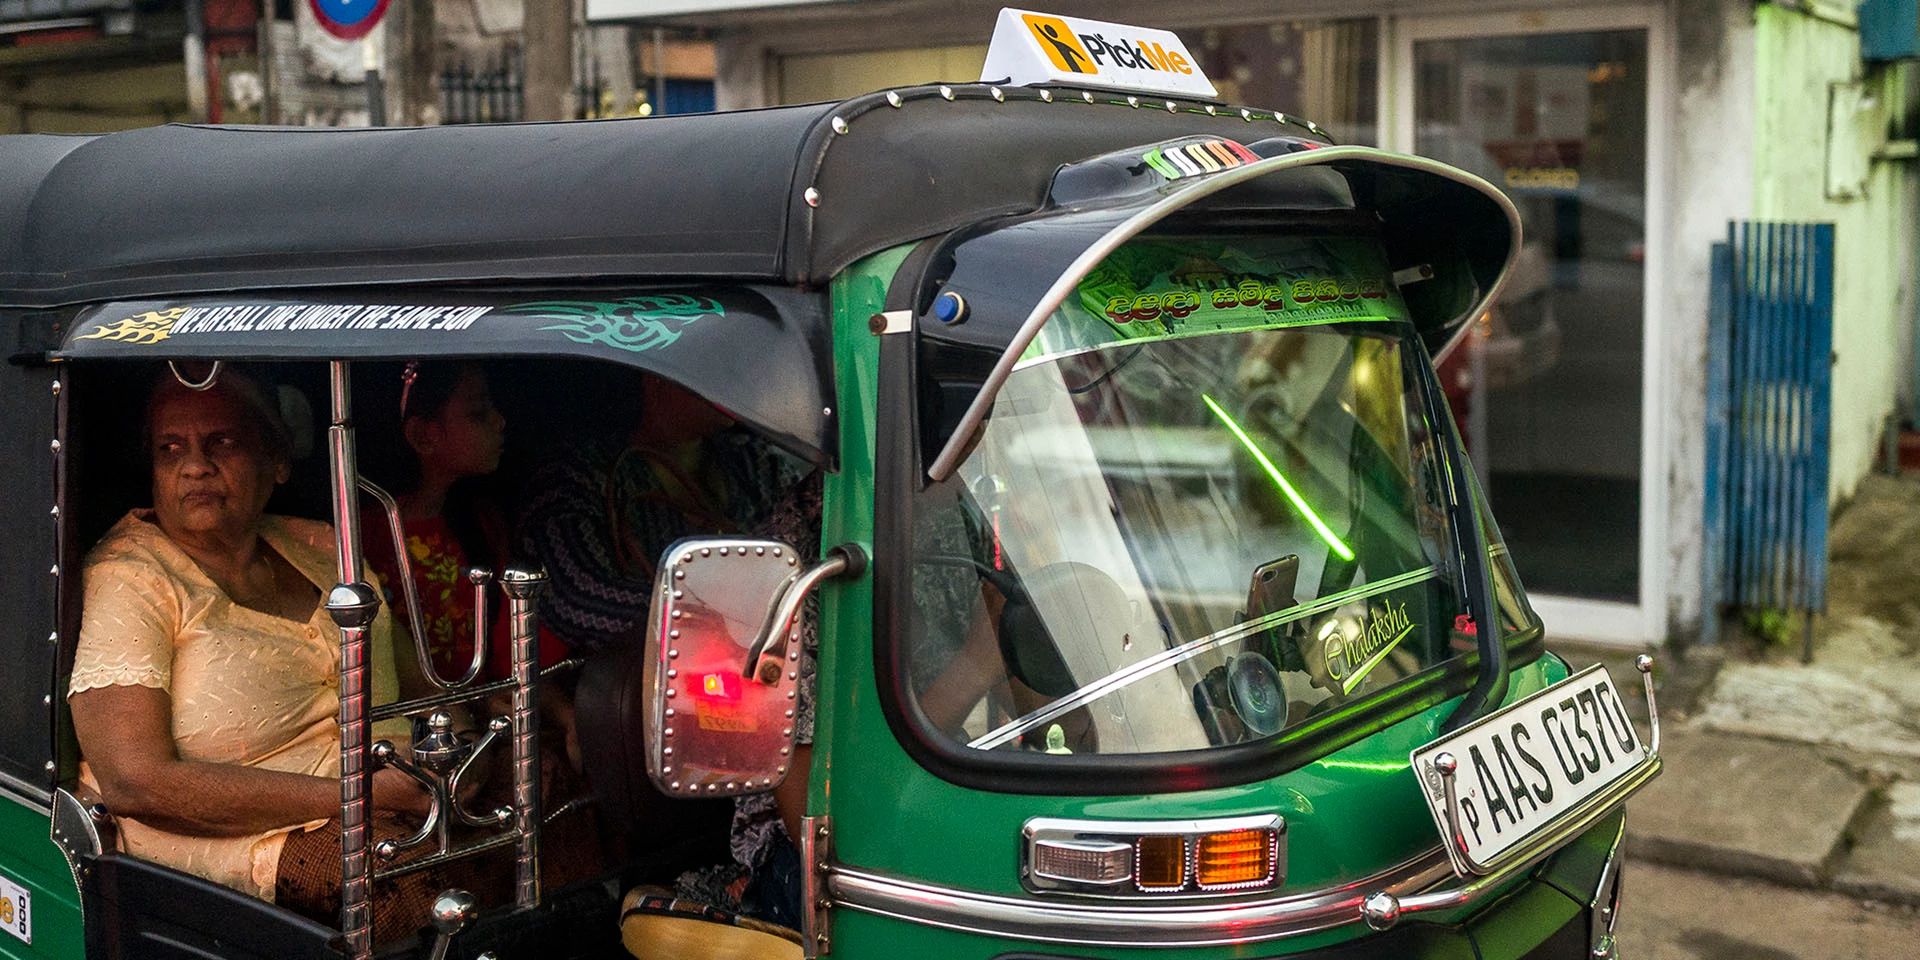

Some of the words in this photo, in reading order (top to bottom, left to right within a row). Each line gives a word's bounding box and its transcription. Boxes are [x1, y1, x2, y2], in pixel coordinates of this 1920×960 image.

[1078, 33, 1192, 75] PickMe
[168, 307, 210, 334] WE
[255, 305, 306, 331] ONE
[289, 304, 364, 331] UNDER
[346, 305, 402, 329] THE
[379, 306, 454, 330] SAME
[432, 306, 494, 331] SUN
[1468, 722, 1554, 833] AAS
[1540, 681, 1636, 785] 0370
